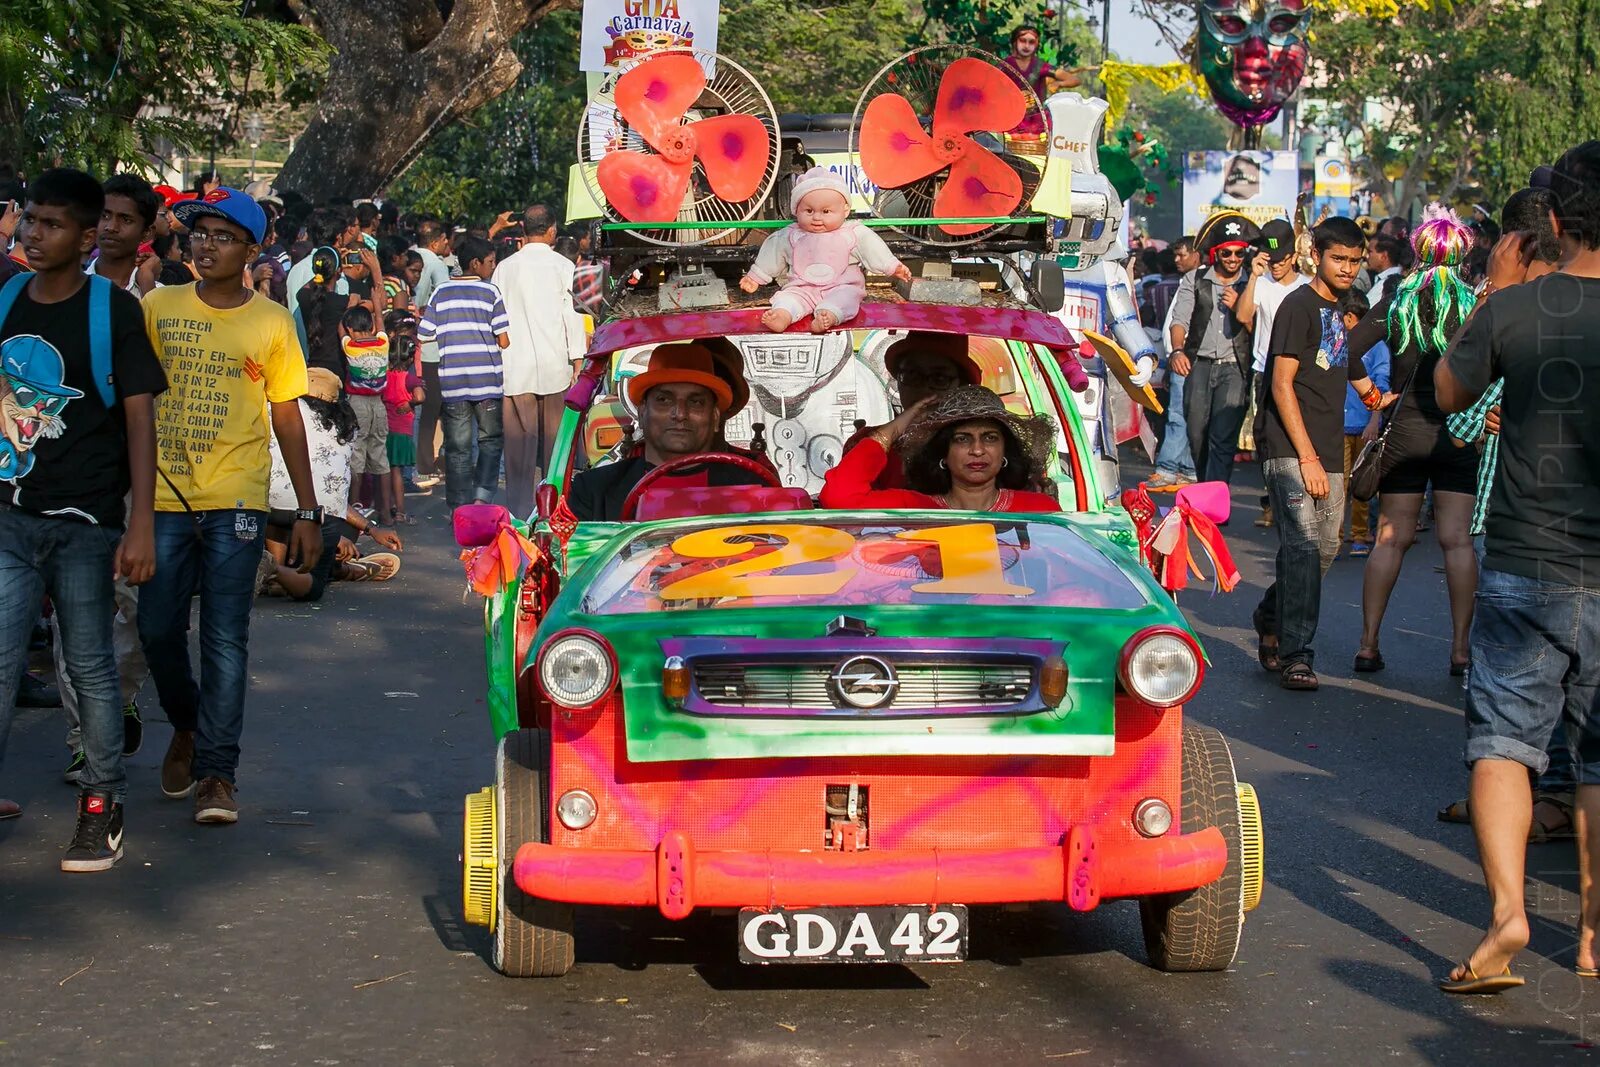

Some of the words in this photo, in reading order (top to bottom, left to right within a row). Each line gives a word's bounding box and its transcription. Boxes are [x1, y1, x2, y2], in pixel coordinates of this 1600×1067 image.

[612, 16, 692, 39] Carnaval
[1053, 135, 1088, 153] CHEF
[183, 319, 213, 332] TECH
[173, 373, 189, 384] 8.5
[191, 375, 202, 386] IN
[205, 377, 217, 388] 12
[187, 415, 210, 427] CRU
[212, 417, 225, 429] IN
[182, 427, 189, 438] 3
[170, 464, 192, 475] USA
[659, 523, 1036, 600] 21
[743, 912, 885, 957] GDA
[890, 912, 960, 956] 42
